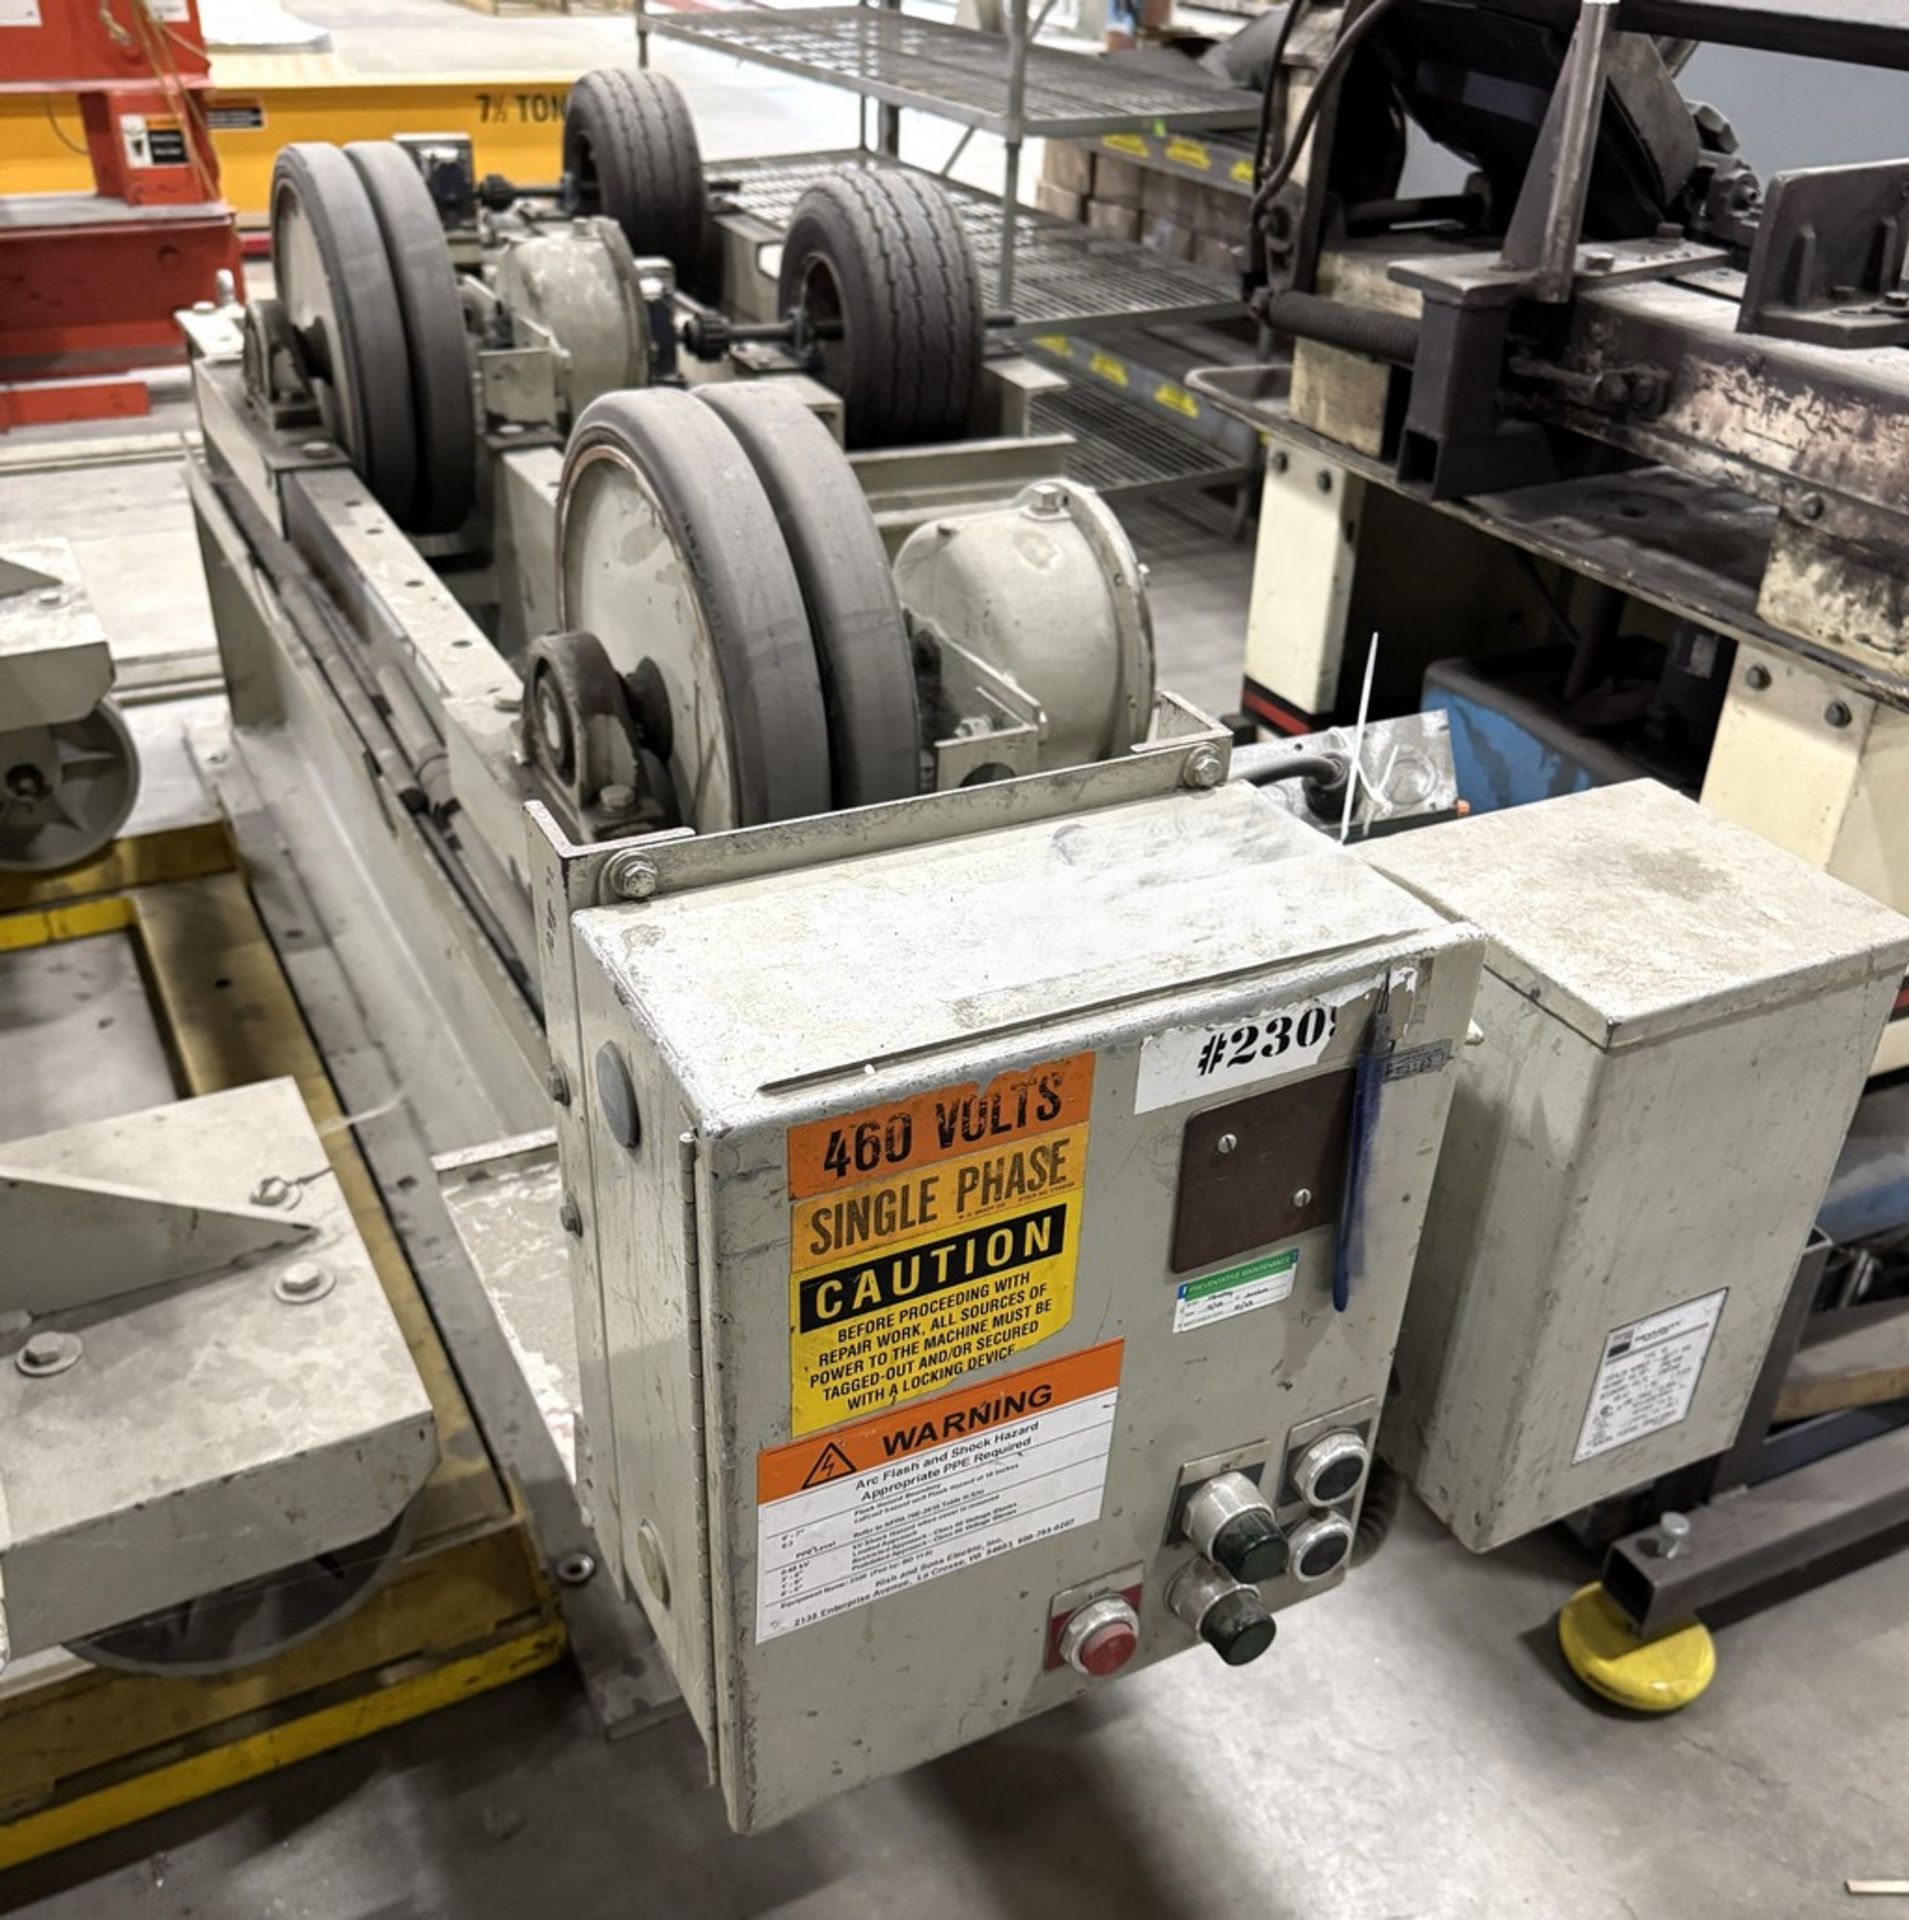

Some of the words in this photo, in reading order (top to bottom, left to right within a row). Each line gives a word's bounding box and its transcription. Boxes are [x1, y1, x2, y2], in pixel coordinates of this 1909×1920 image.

[823, 1112, 912, 1178] 460
[936, 1072, 1064, 1149] VOLTS
[810, 1176, 939, 1254] SINGLE
[956, 1138, 1070, 1213] PHASE
[816, 1216, 1051, 1320] CAUTION
[838, 1317, 894, 1343] BEFORE
[899, 1282, 989, 1323] PROCEEDING
[995, 1271, 1030, 1293] WITH
[809, 1360, 864, 1388] POWER
[869, 1352, 888, 1369] TO
[893, 1344, 919, 1363] THE
[924, 1324, 987, 1355] MACHINE
[992, 1309, 1031, 1331] MUST
[1036, 1299, 1053, 1314] BE
[819, 1341, 872, 1367] REPAIR
[930, 1313, 956, 1332] ALL
[961, 1294, 1025, 1321] SOURCES
[1029, 1283, 1048, 1299] OF
[823, 1363, 914, 1401] TAGGED-OUT
[919, 1344, 973, 1370] AND/OR
[976, 1320, 1039, 1350] SECURED
[847, 1388, 884, 1410] WITH
[888, 1383, 898, 1396] A
[903, 1364, 963, 1393] LOCKING
[882, 1384, 1053, 1457] WARNING
[855, 1475, 879, 1491] Arc
[882, 1460, 920, 1482] Flash
[923, 1450, 948, 1468] and
[950, 1439, 991, 1460] Shock
[994, 1421, 1040, 1445] Hazard
[860, 1469, 940, 1502] Appropriate
[943, 1459, 970, 1474] PPE
[973, 1437, 1032, 1464] Required
